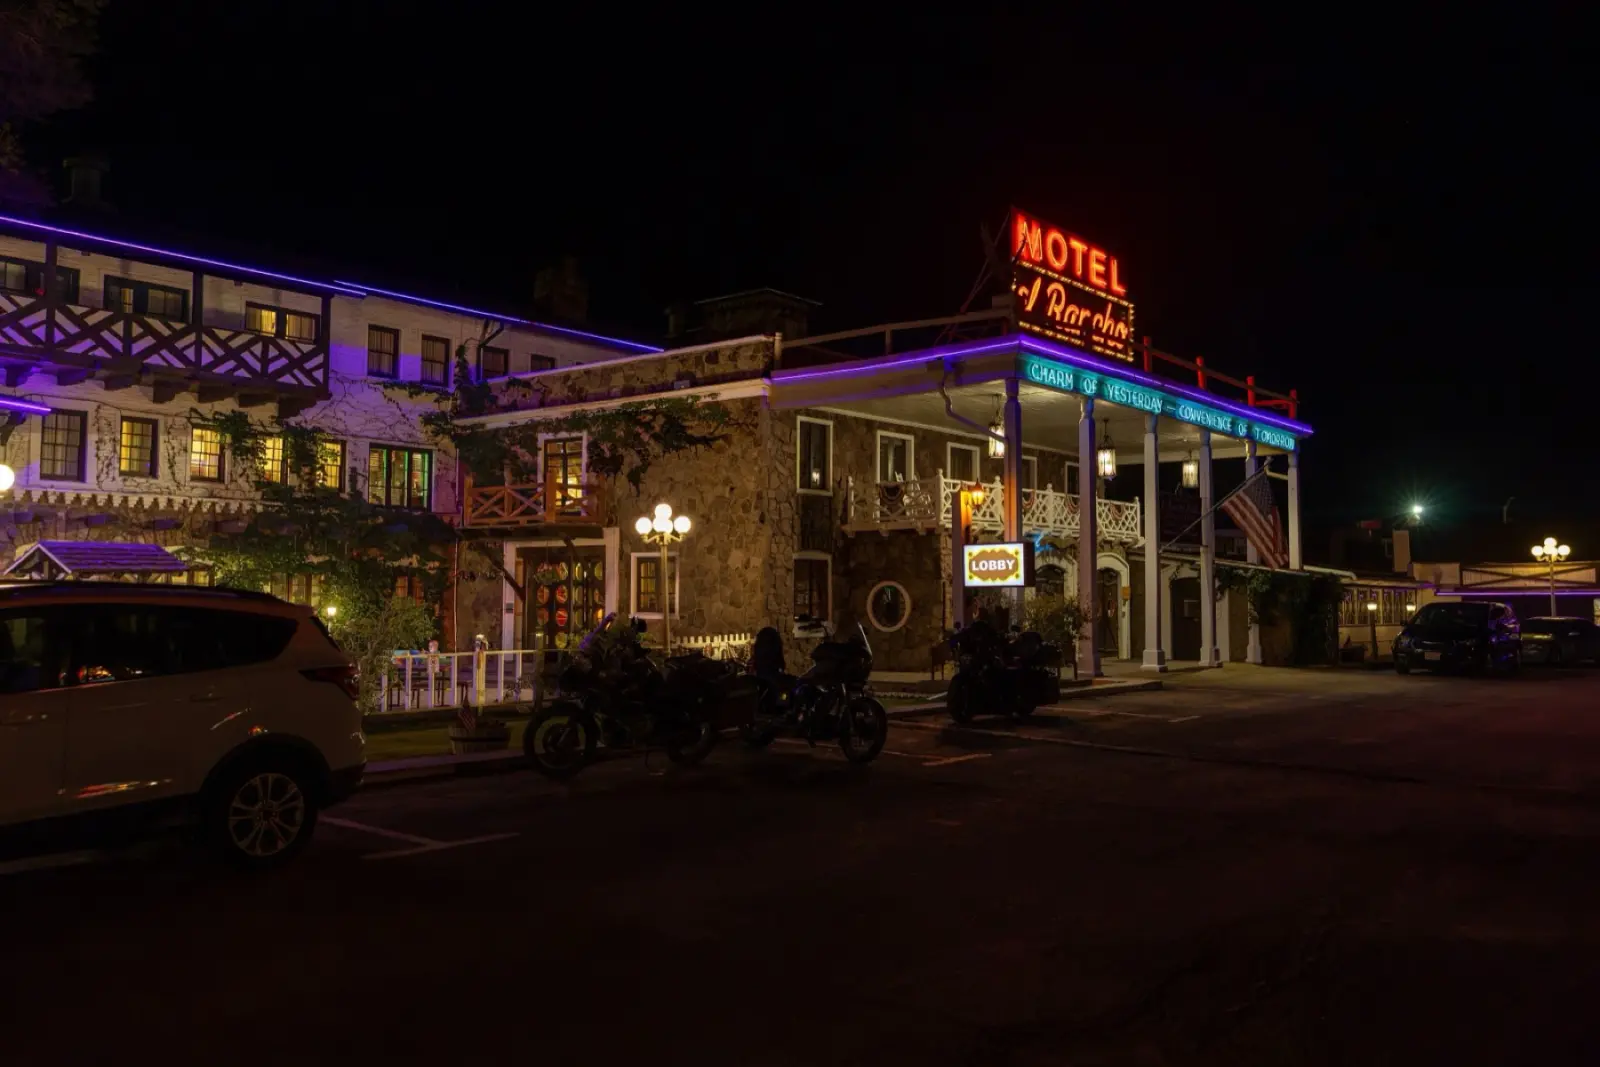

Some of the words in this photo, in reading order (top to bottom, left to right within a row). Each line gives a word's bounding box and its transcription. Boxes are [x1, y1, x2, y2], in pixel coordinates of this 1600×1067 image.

[1017, 213, 1126, 296] MOTEL
[1031, 363, 1074, 390] CHARM
[1083, 378, 1098, 394] OF
[1107, 384, 1162, 413] YESTERDAY
[1179, 405, 1232, 431] CONVENIENCE
[1238, 423, 1248, 436] OF
[971, 559, 1016, 571] LOBBY
